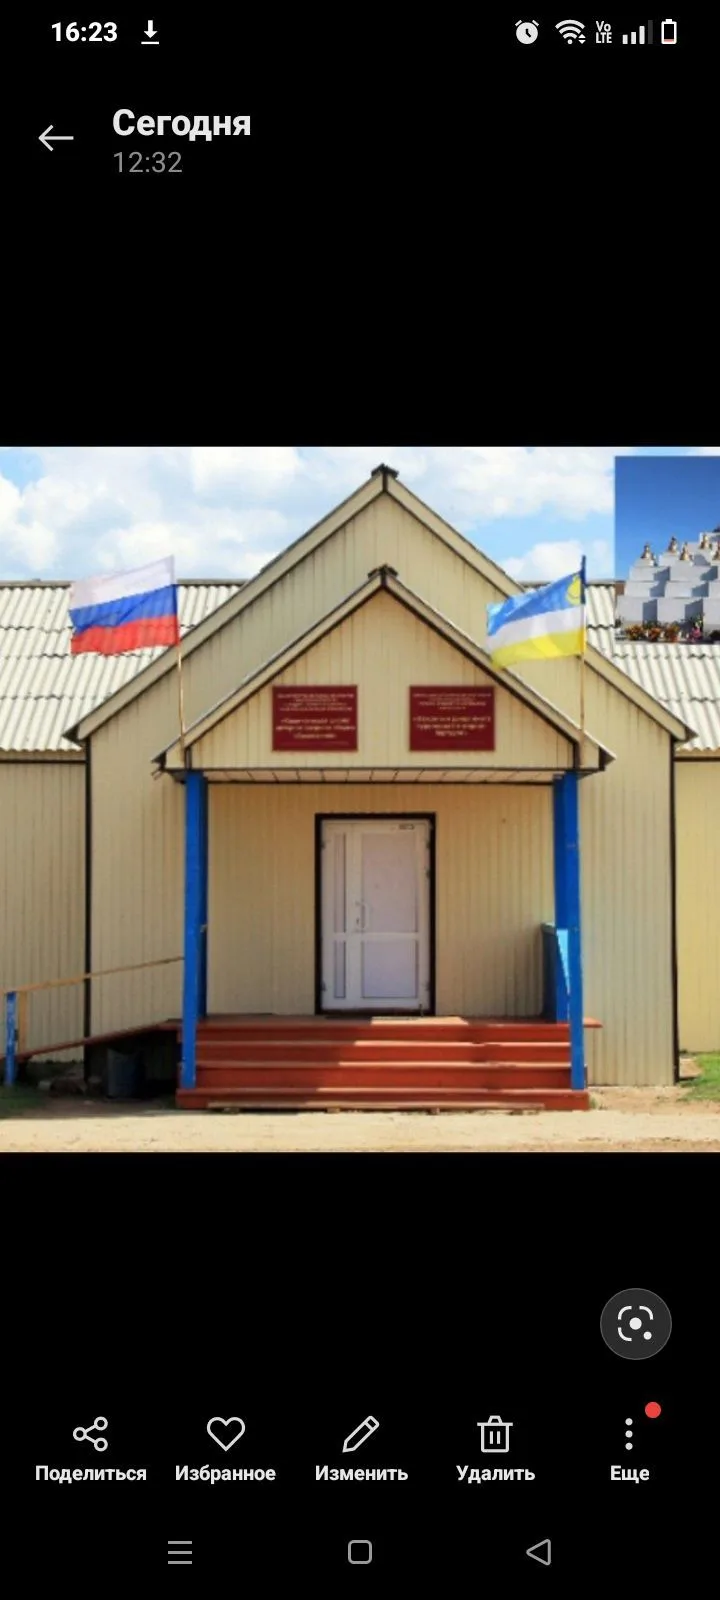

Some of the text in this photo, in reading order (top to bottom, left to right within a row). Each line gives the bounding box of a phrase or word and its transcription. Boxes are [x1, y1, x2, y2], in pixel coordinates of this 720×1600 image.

[51, 22, 118, 42] 16:23
[595, 20, 612, 32] Vo
[595, 31, 613, 44] LTE
[112, 108, 251, 141] Сегодня
[113, 151, 183, 173] 12:32
[35, 1465, 147, 1484] Поделиться
[175, 1464, 277, 1485] Избранное
[315, 1465, 409, 1481] Изменить
[455, 1464, 536, 1484] Удалить
[610, 1464, 650, 1484] Еще
